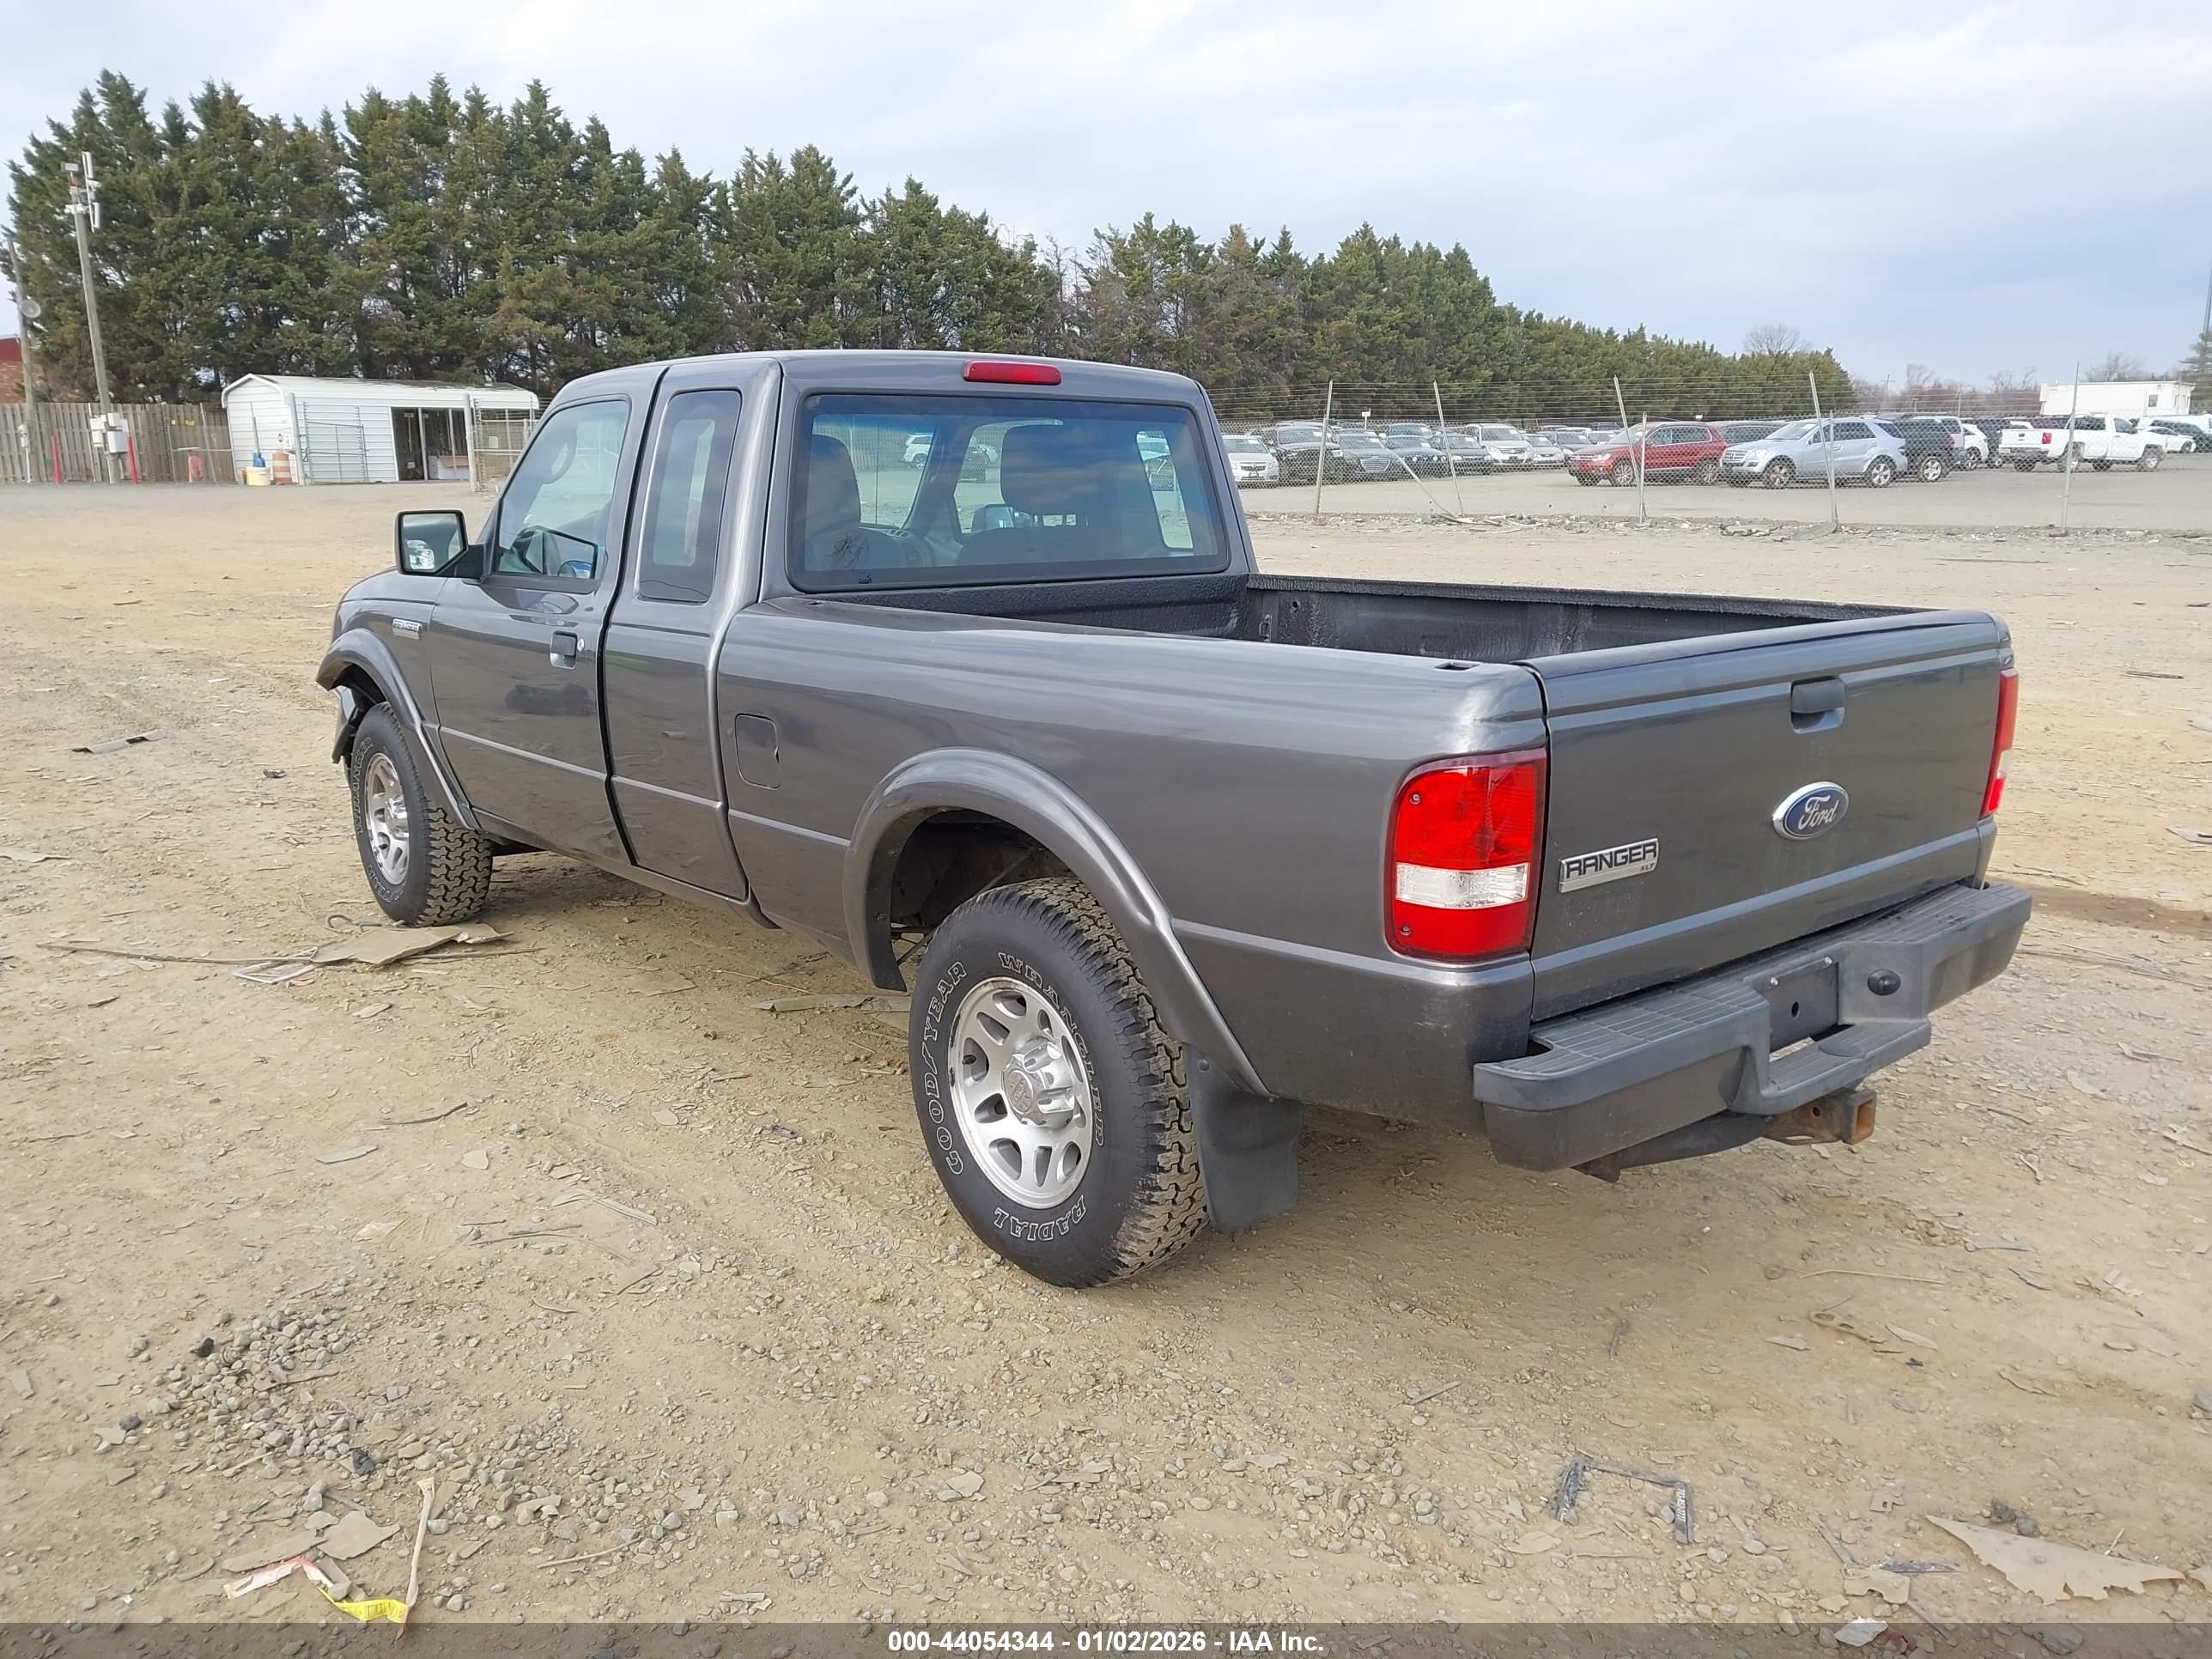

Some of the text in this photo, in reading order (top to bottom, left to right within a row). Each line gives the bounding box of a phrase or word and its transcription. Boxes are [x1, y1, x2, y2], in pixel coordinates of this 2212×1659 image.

[1798, 794, 1839, 831] Ford
[1565, 842, 1657, 880] RANGER
[997, 951, 1104, 1146] WRANGLER
[994, 1194, 1087, 1242] RADIAL
